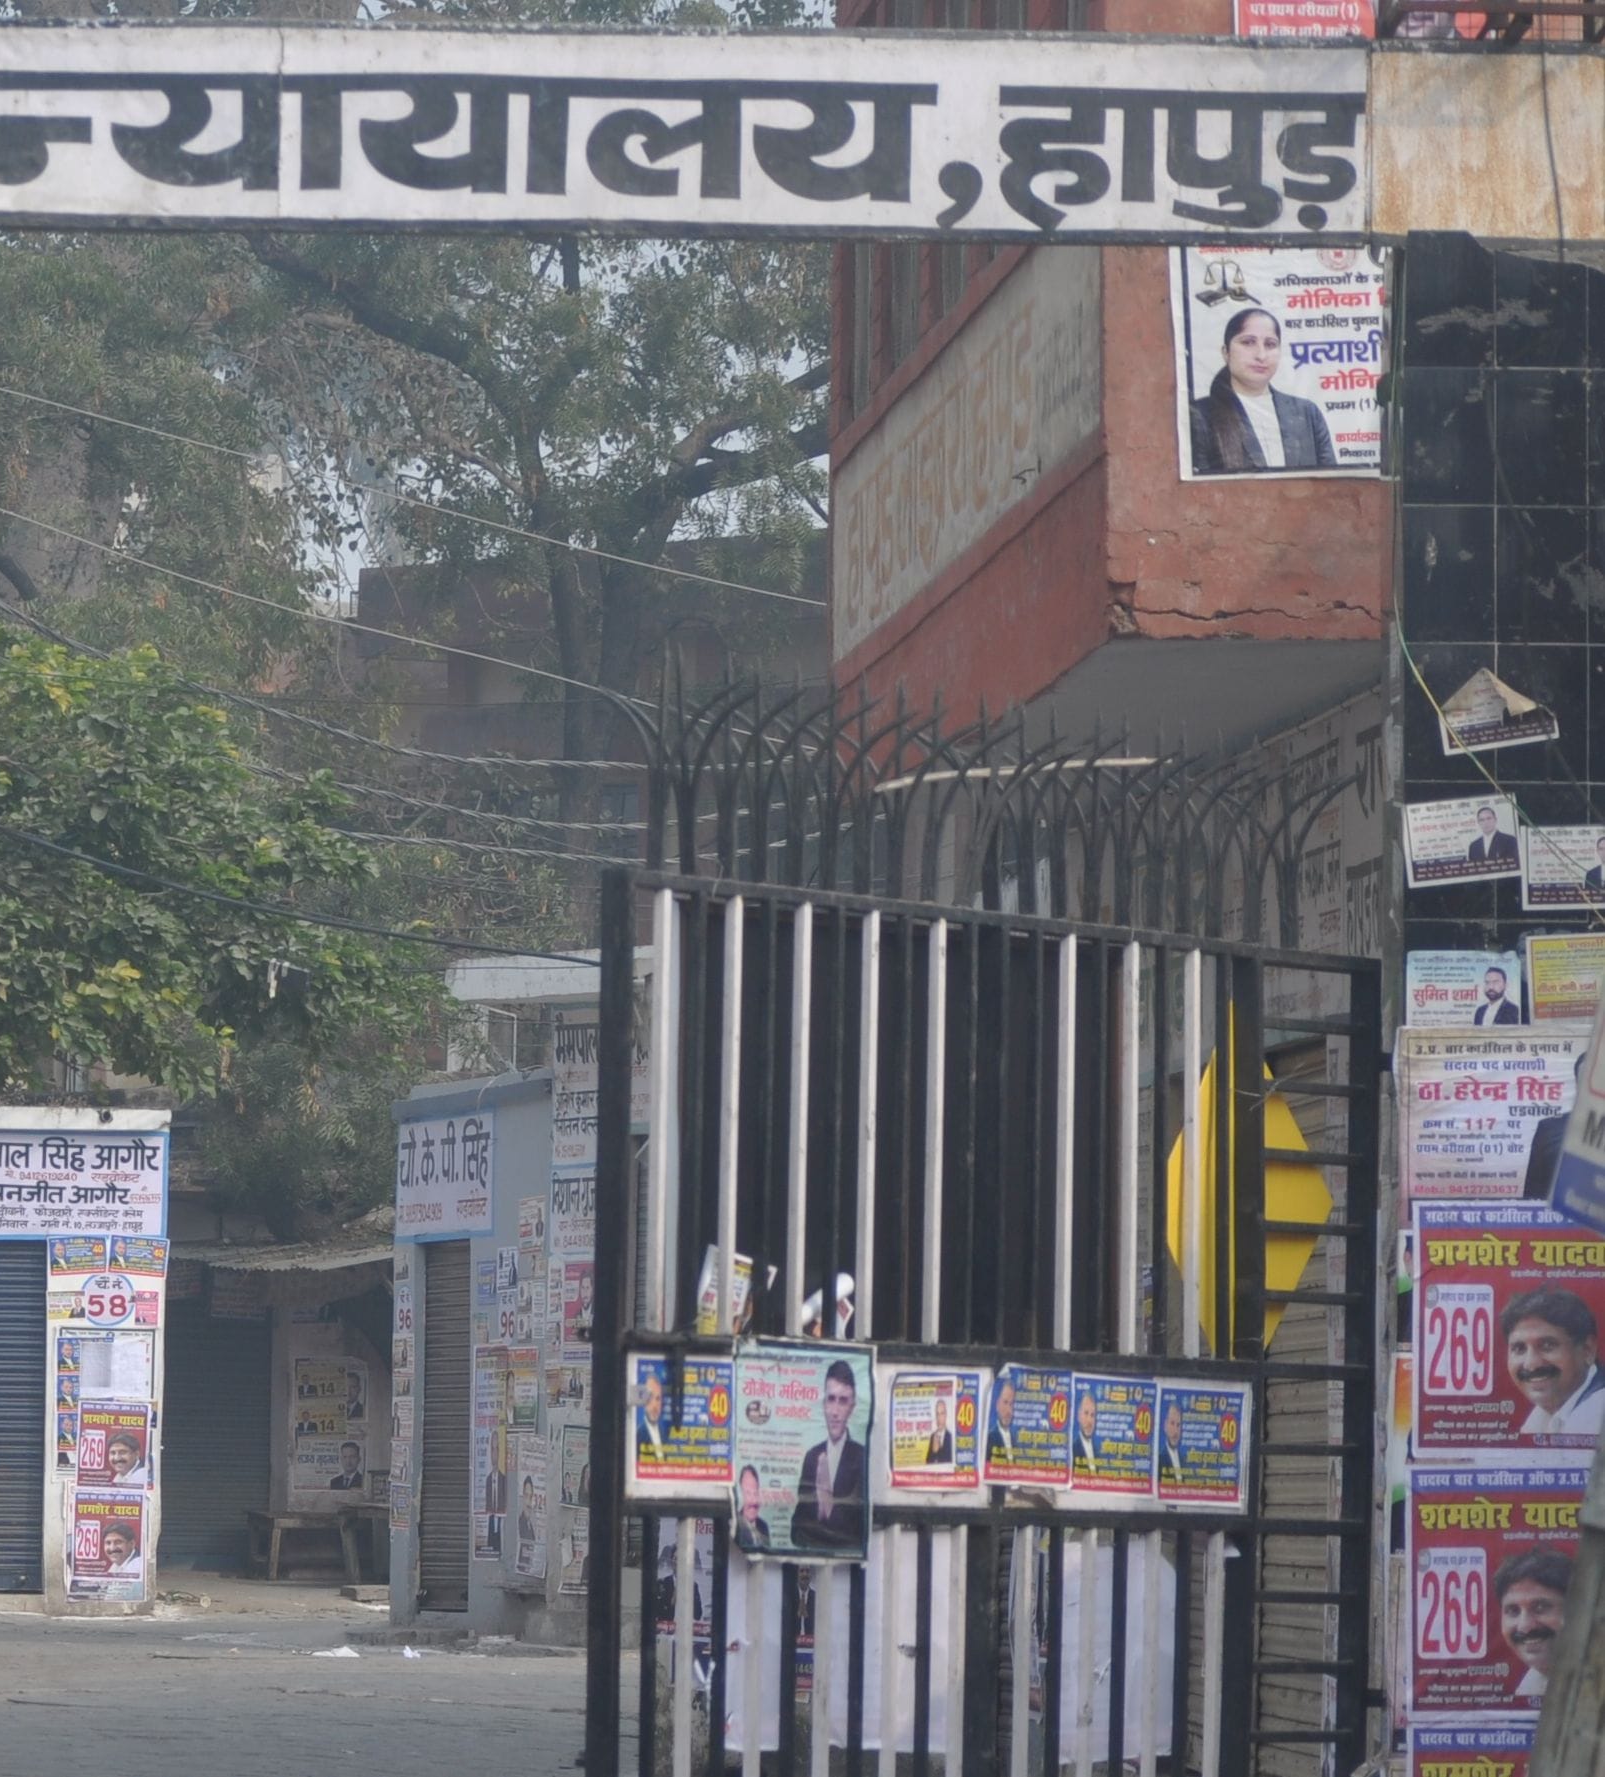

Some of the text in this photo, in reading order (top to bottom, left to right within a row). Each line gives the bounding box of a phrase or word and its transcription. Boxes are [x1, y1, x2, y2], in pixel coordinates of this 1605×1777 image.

[998, 84, 1366, 232] हापुड़
[1287, 288, 1371, 310] मोनिका
[1320, 368, 1381, 391] मोनि
[1413, 984, 1479, 1007] सुमित शर्मा
[1517, 1075, 1565, 1101] सिंह
[1509, 1103, 1563, 1118] एडवोकेट
[1464, 1118, 1496, 1130] 117
[38, 1136, 87, 1173] सिंह
[90, 1138, 161, 1171] आगौर
[68, 1183, 131, 1205] आगौर
[1426, 1232, 1520, 1267] शमशेर
[88, 1294, 127, 1317] 58
[399, 1309, 411, 1330] 96
[500, 1311, 514, 1338] 96
[1428, 1307, 1491, 1391] 269
[319, 1382, 335, 1395] 14
[710, 1394, 728, 1416] 40
[957, 1401, 974, 1425] 40
[1049, 1400, 1067, 1423] 40
[320, 1420, 335, 1432] 14
[1135, 1409, 1151, 1434] 40
[1220, 1419, 1237, 1443] 40
[81, 1437, 104, 1470] 269
[1417, 1473, 1450, 1487] सदस्य
[1454, 1473, 1473, 1486] बार
[1477, 1471, 1524, 1486] काउंसिल
[1418, 1497, 1582, 1530] शमशेर याद
[76, 1526, 99, 1559] 269
[1422, 1570, 1484, 1654] 269
[1456, 1732, 1475, 1745] बार
[1479, 1730, 1526, 1745] काउंसिल
